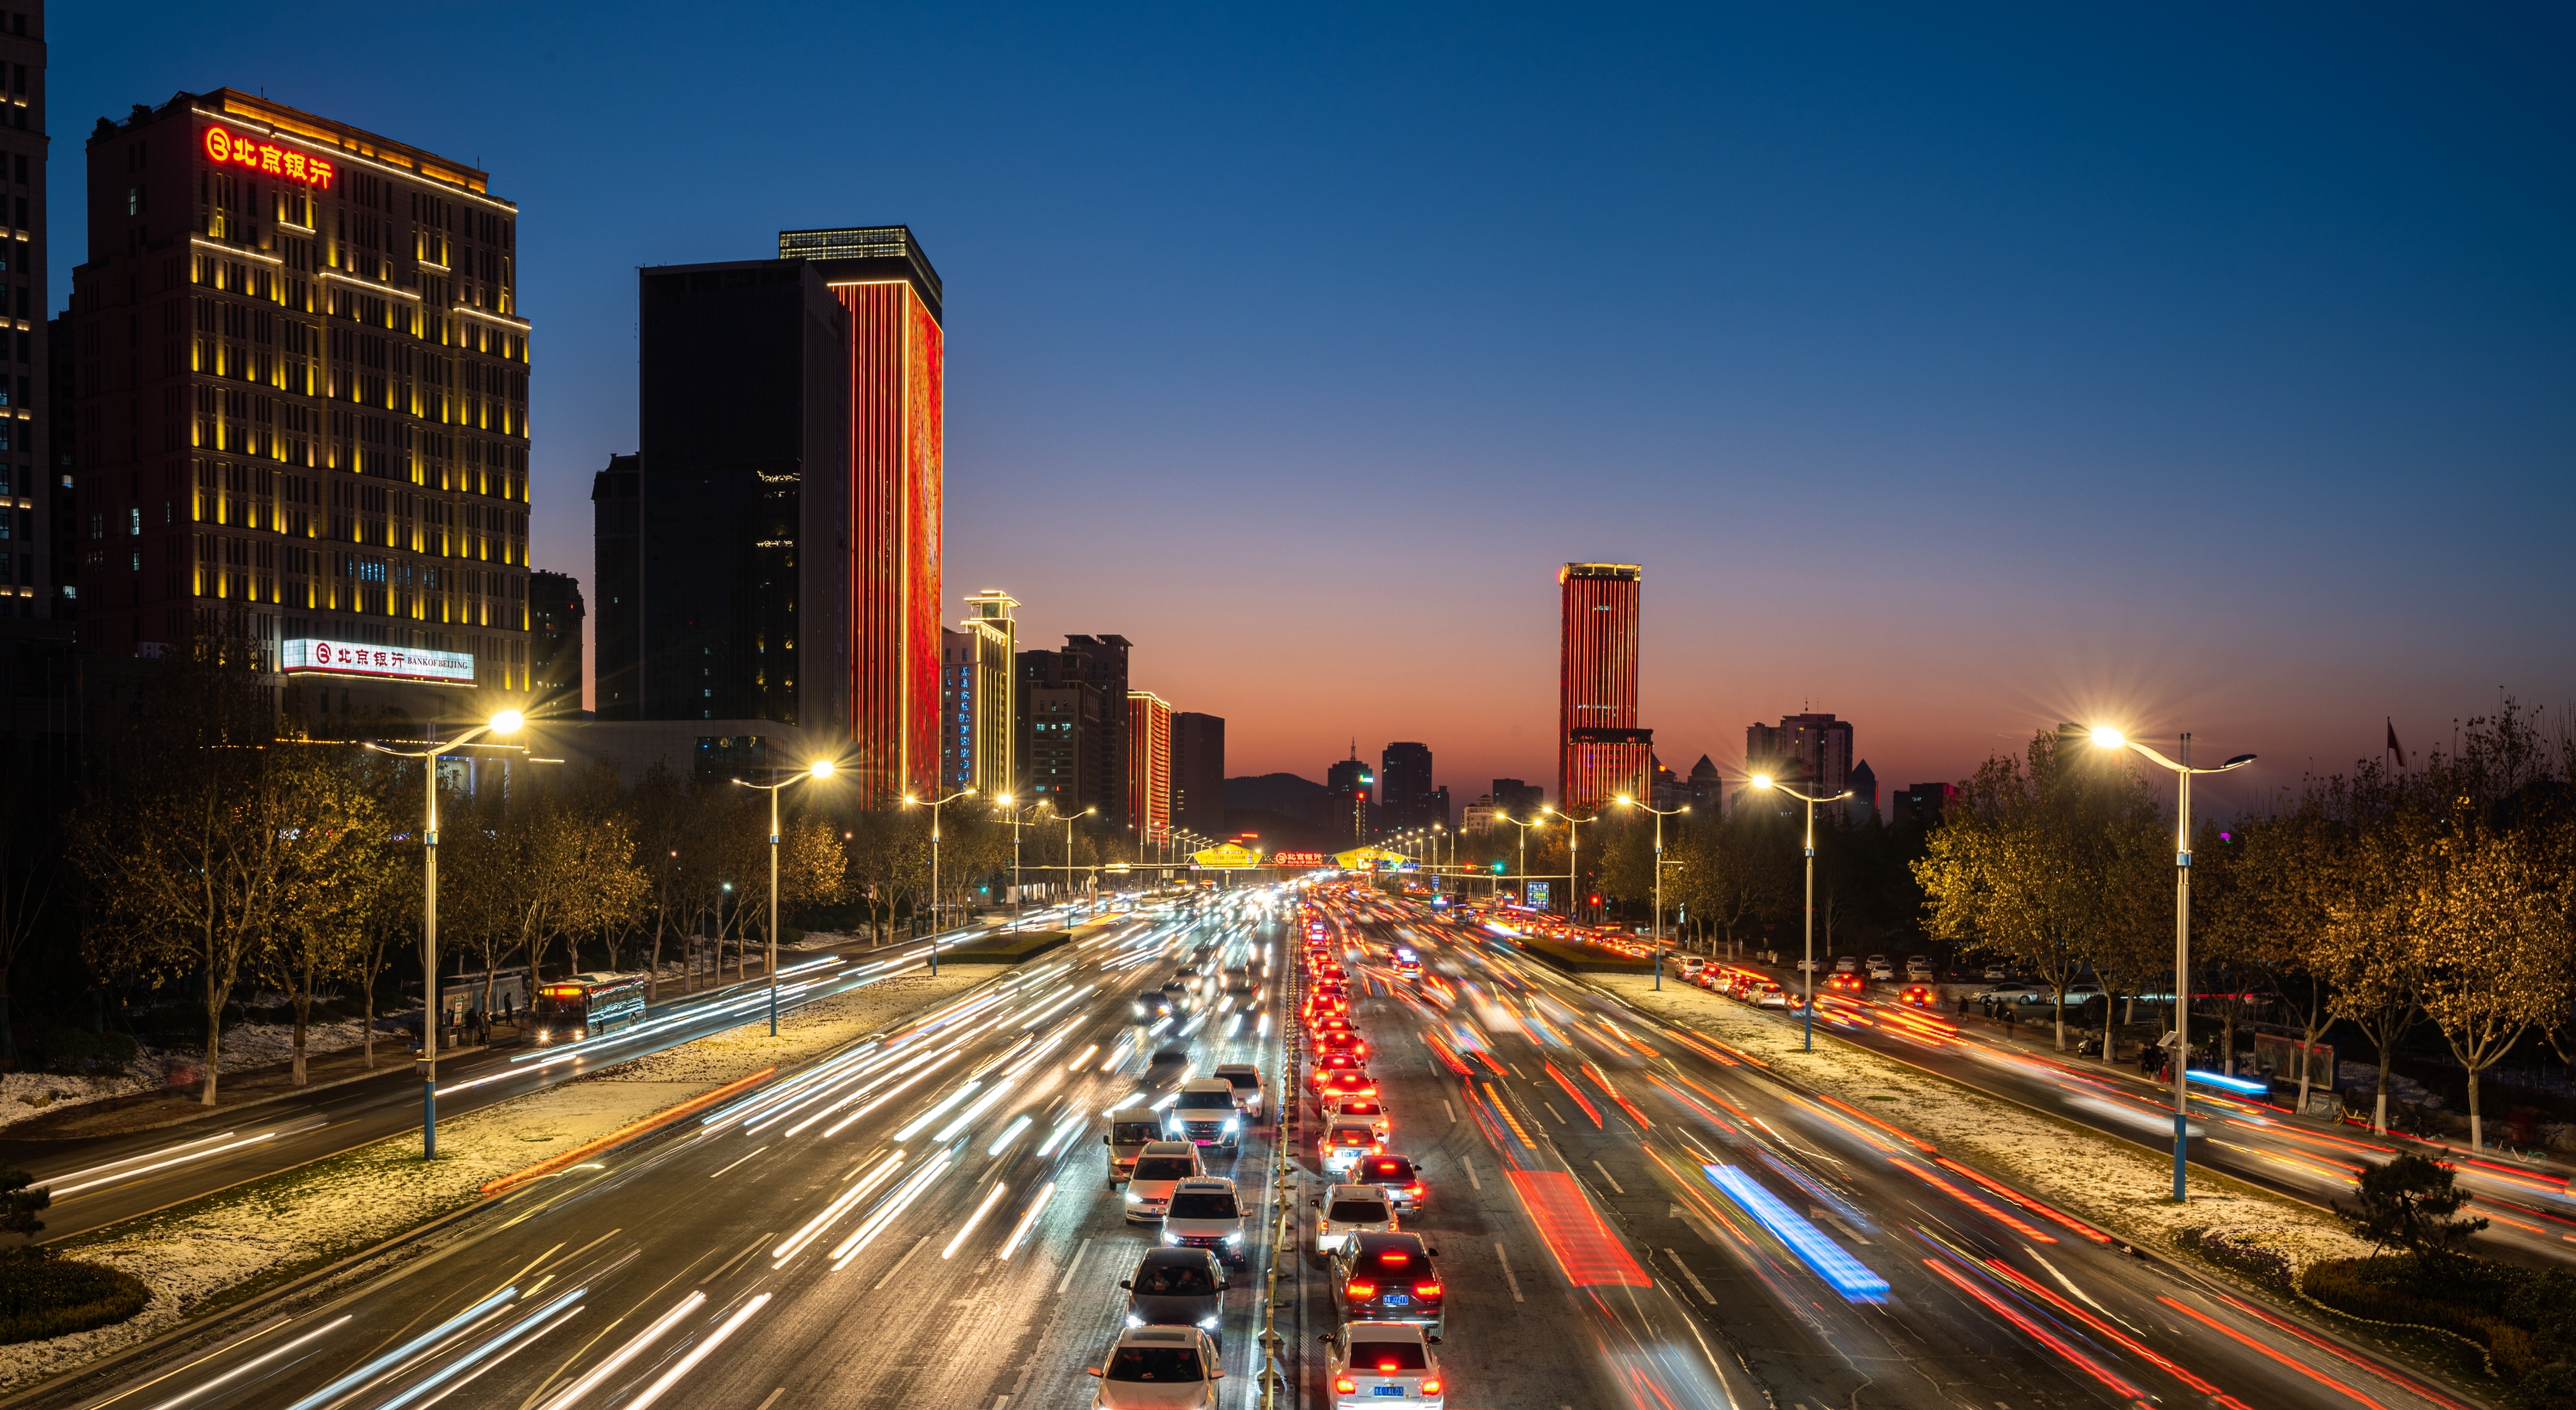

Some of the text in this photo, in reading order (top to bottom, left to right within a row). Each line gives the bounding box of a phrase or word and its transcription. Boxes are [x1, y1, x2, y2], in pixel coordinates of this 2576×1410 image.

[233, 138, 332, 189] 北京银行
[337, 648, 404, 668] 北京银行
[407, 657, 428, 666] BANK
[438, 659, 468, 670] BEIJING
